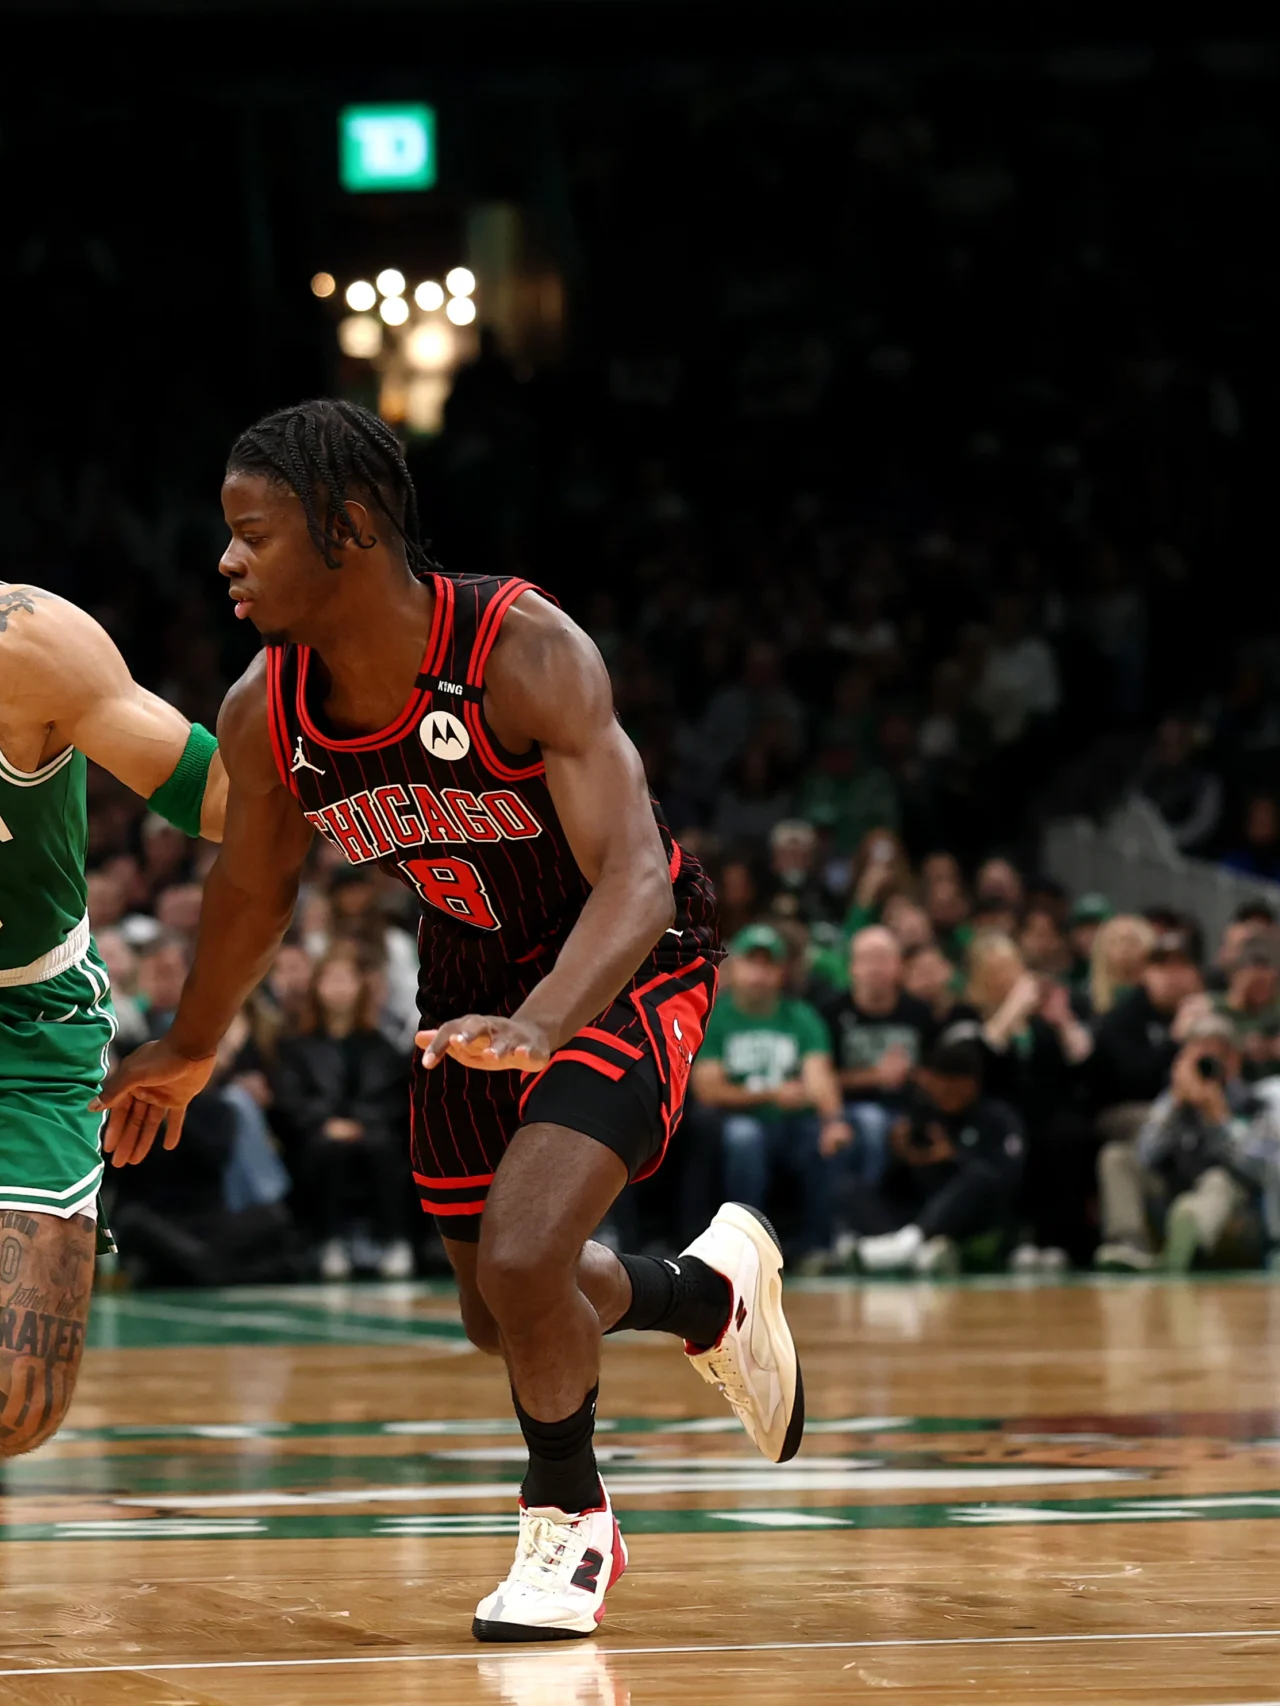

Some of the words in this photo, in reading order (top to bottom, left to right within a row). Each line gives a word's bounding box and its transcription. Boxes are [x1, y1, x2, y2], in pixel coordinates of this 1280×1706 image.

[347, 117, 428, 177] TD
[437, 680, 464, 696] KING
[397, 855, 502, 931] 8
